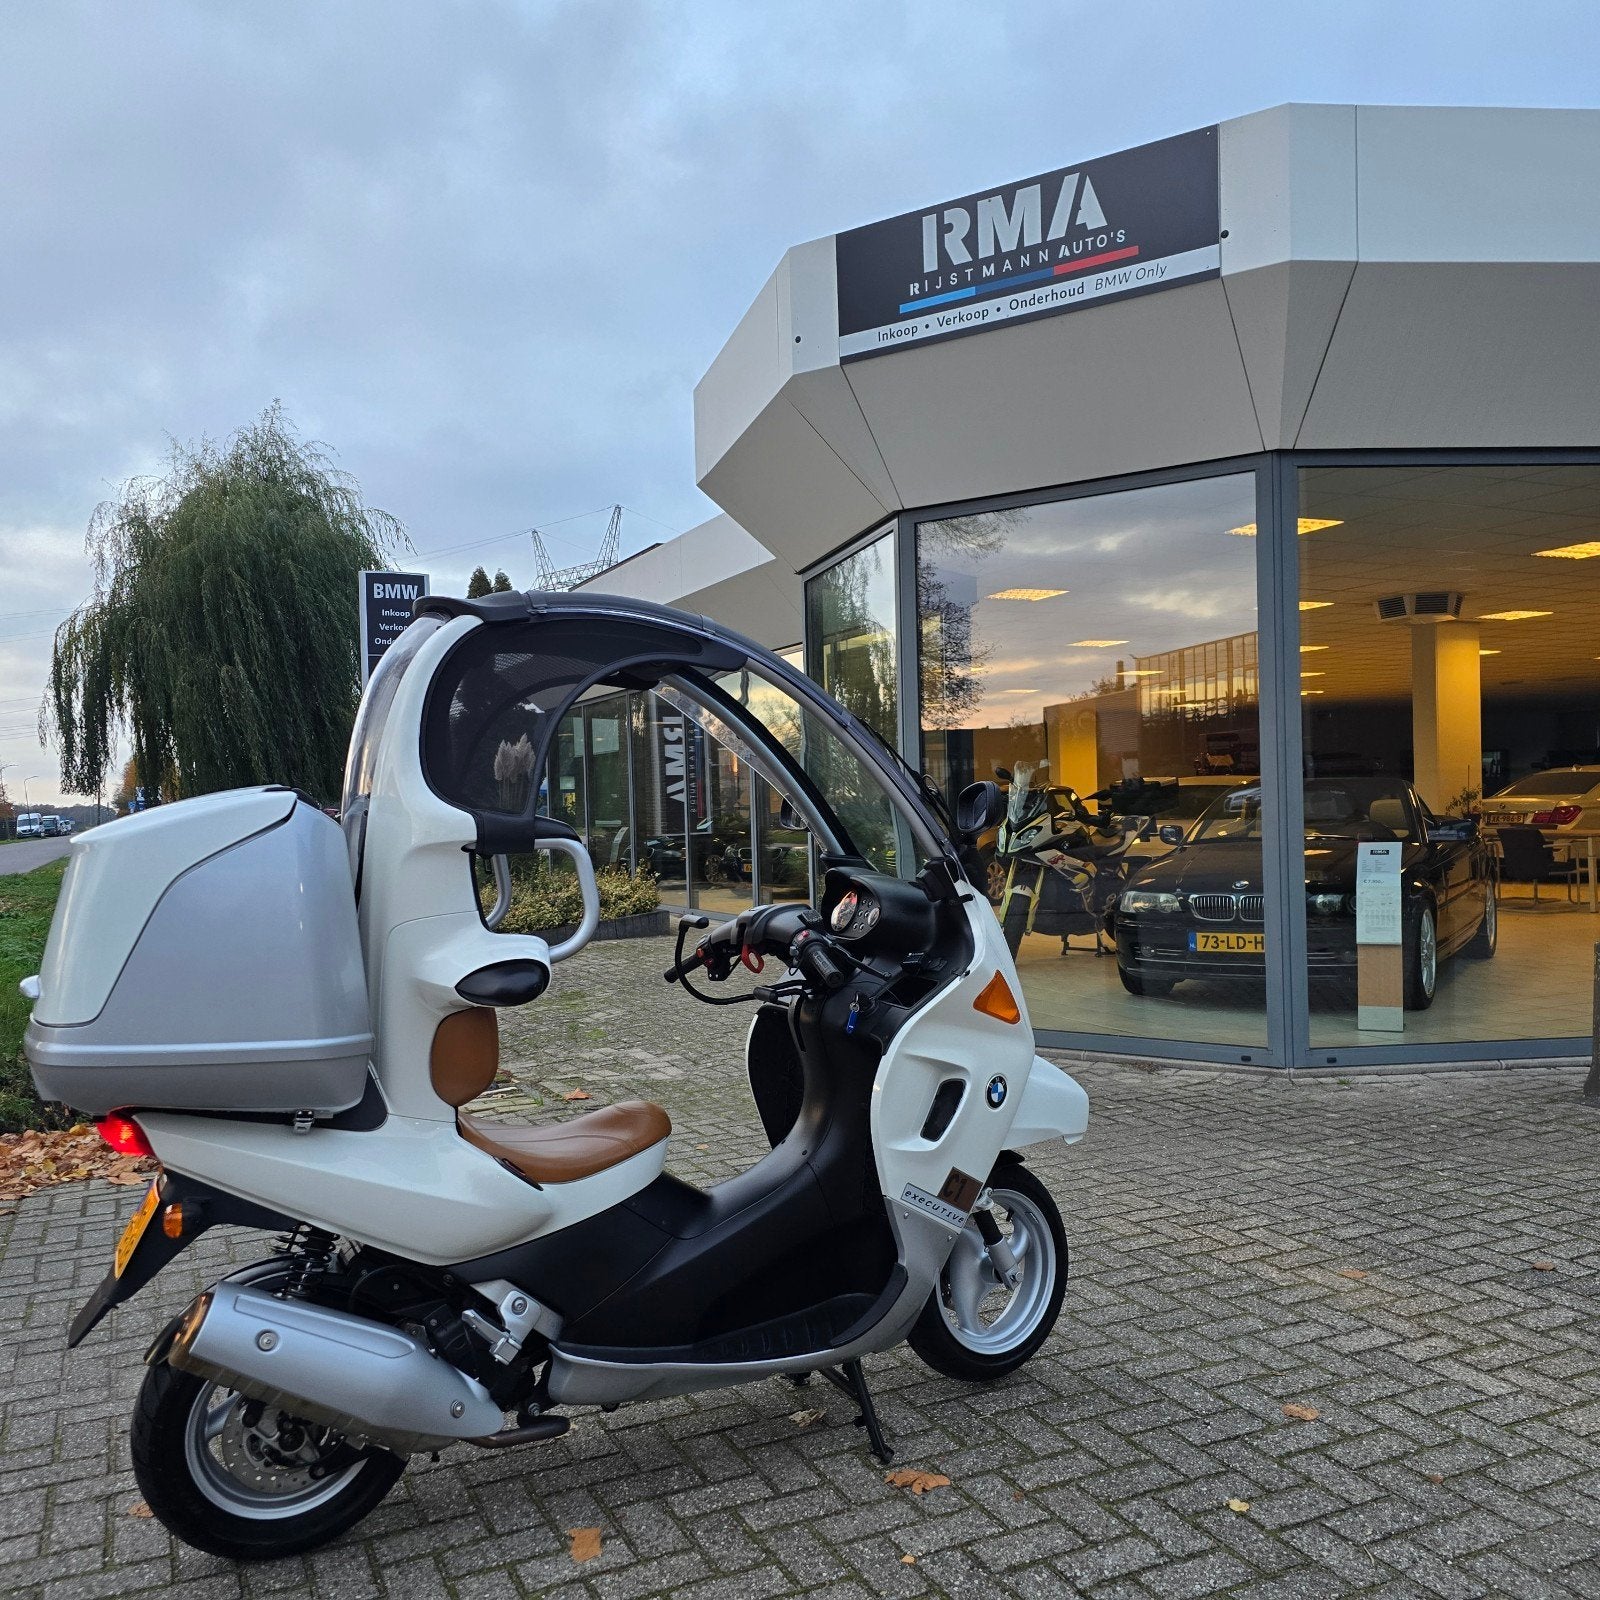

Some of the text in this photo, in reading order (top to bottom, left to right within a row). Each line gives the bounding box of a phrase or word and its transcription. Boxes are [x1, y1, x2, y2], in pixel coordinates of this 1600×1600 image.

[922, 172, 1108, 274] RMA
[909, 229, 1127, 297] RIJSTMANN AUTO'S
[877, 263, 1168, 342] Inkoop Verkoop Onderhoud BMW Only
[373, 583, 418, 600] BMW
[381, 608, 411, 619] Inkoop
